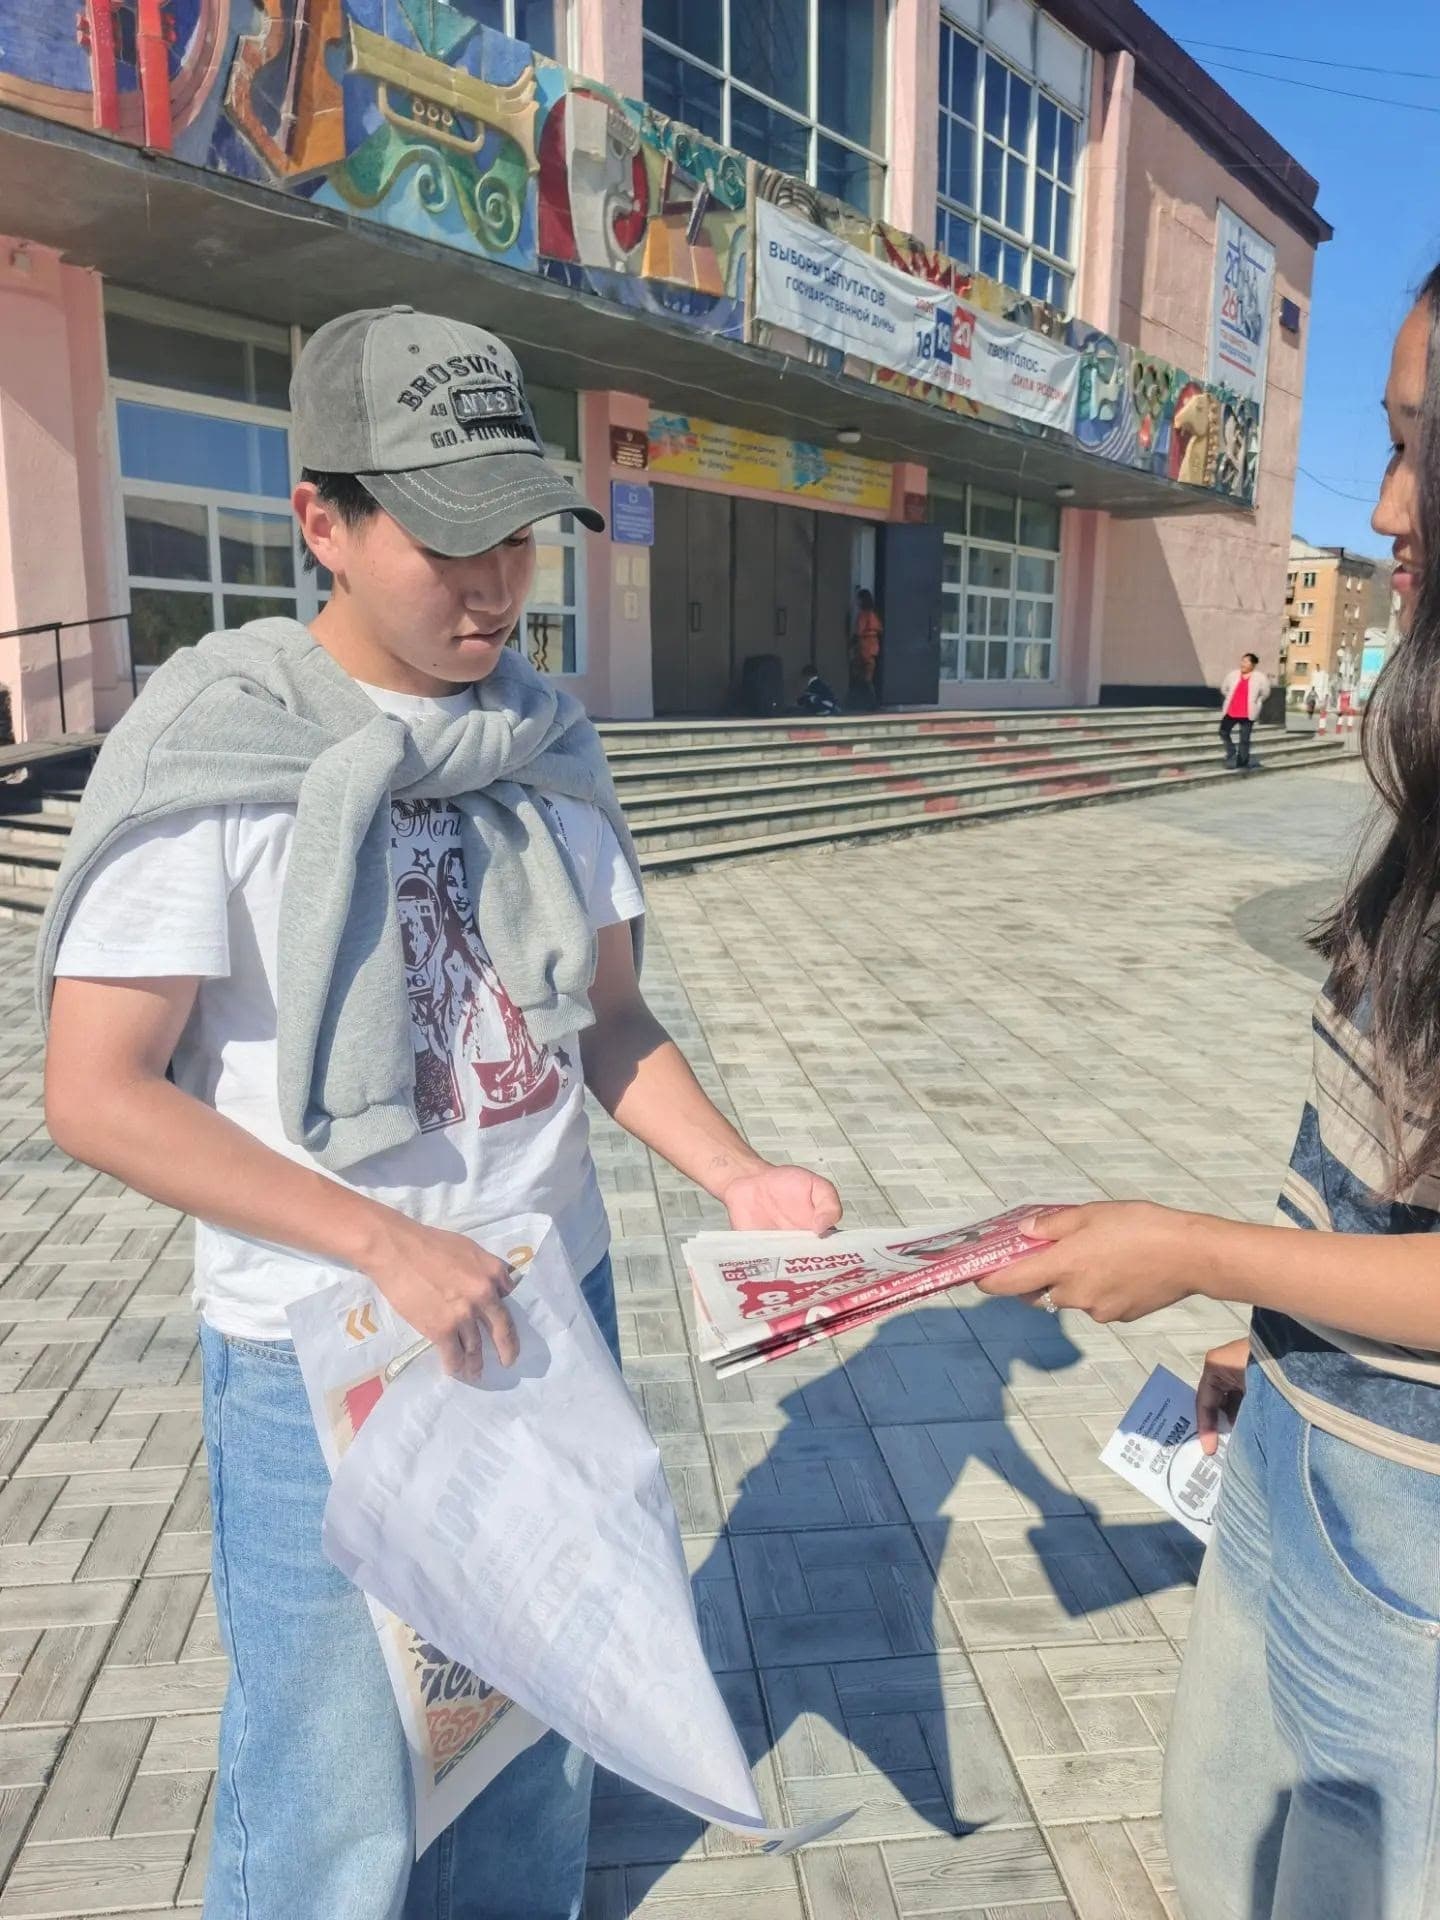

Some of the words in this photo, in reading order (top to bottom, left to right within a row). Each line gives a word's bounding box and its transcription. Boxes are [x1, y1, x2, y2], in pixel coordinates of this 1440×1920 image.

[769, 241, 823, 279] ВЫБОРЫ
[821, 260, 886, 307] ДЕПУТАТОВ
[785, 276, 869, 323] ГОСУДАРСТВЕННОЙ
[916, 331, 931, 360] 18
[431, 403, 448, 417] 49
[459, 391, 508, 414] NYS
[784, 1253, 859, 1266] НАРОДА
[786, 1258, 864, 1274] ПАРТИЯ
[725, 1269, 745, 1282] 20
[1147, 1415, 1191, 1475] СКАЖИ
